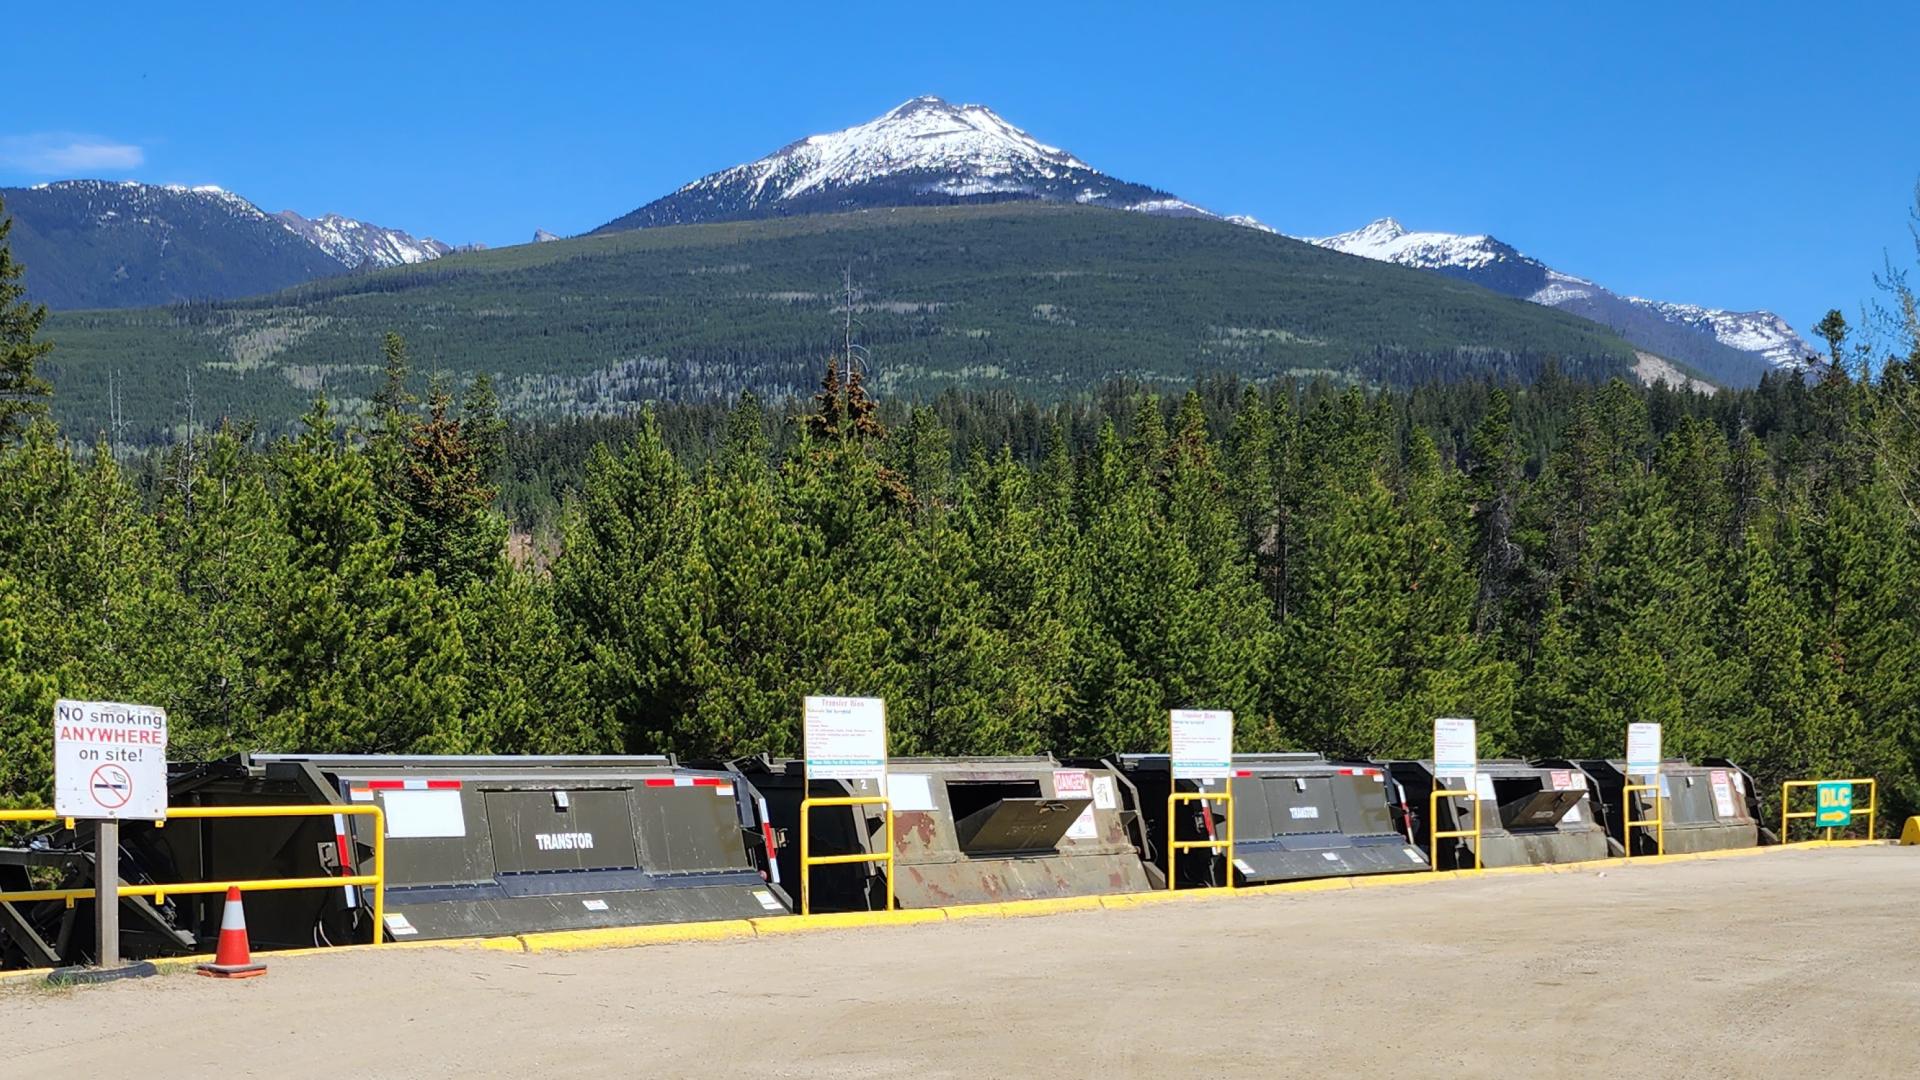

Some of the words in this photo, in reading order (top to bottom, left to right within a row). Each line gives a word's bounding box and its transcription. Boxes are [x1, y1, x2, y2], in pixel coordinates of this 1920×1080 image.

[59, 706, 83, 721] NO
[90, 710, 162, 729] smoking
[60, 726, 161, 744] ANYWHERE
[79, 749, 99, 760] on
[105, 748, 143, 762] site!
[860, 779, 868, 789] 2
[1056, 774, 1088, 790] DANGER
[1820, 787, 1851, 808] DLC
[535, 832, 594, 850] TRANSTOR
